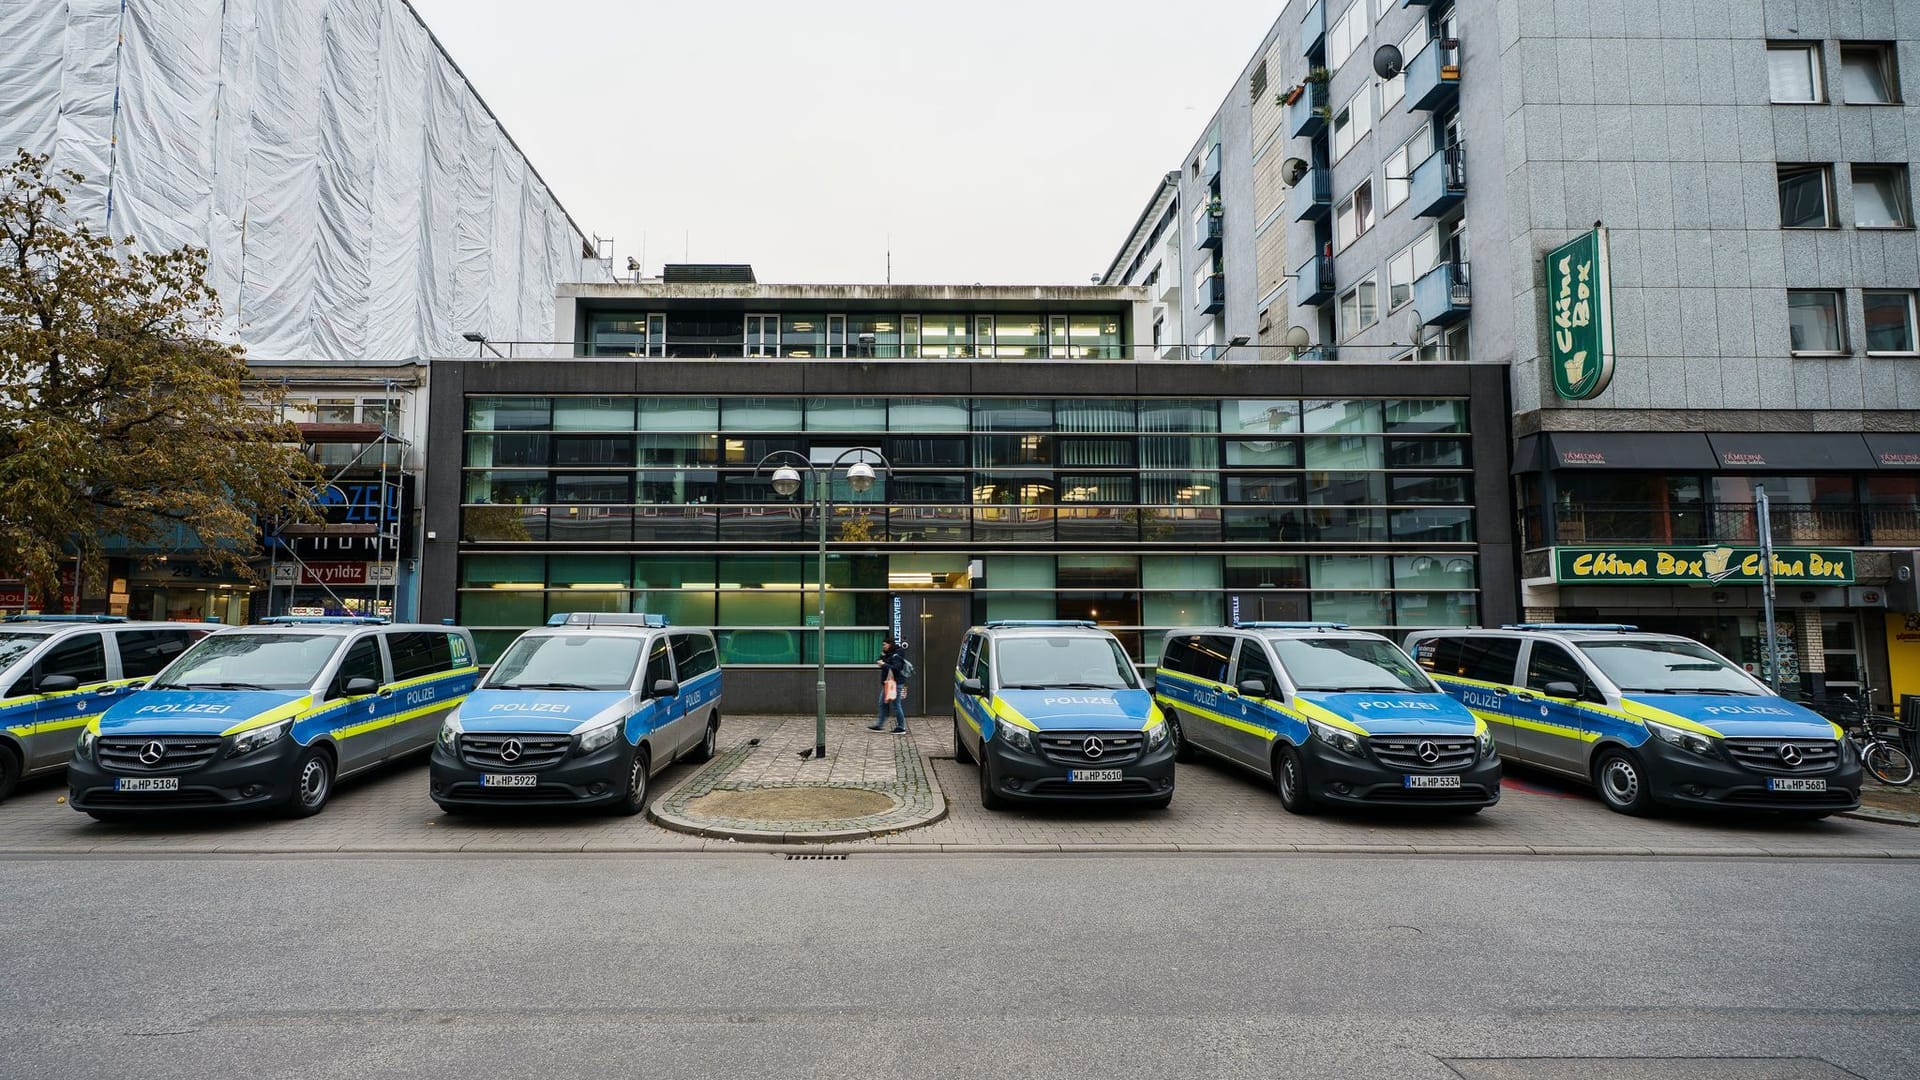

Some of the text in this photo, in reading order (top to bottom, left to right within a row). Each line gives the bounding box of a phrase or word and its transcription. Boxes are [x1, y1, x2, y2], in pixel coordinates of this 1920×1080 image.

[1555, 254, 1592, 354] China Box
[1573, 552, 1703, 578] China Box
[1741, 553, 1845, 579] Cina Box
[451, 637, 466, 658] 110
[407, 687, 435, 705] POLIZEI
[1044, 697, 1119, 705] POLIZEI
[1193, 689, 1217, 707] POLIZEI
[1463, 690, 1501, 710] POLIZEI
[136, 704, 232, 714] POLIZEI
[488, 703, 571, 713] POLIZEI
[1358, 701, 1440, 711] POLIZEI
[1704, 705, 1795, 716] POLIZEI
[153, 779, 178, 790] 5184
[514, 775, 536, 786] 5922
[1440, 776, 1460, 787] 5334
[1805, 779, 1826, 790] 5681
